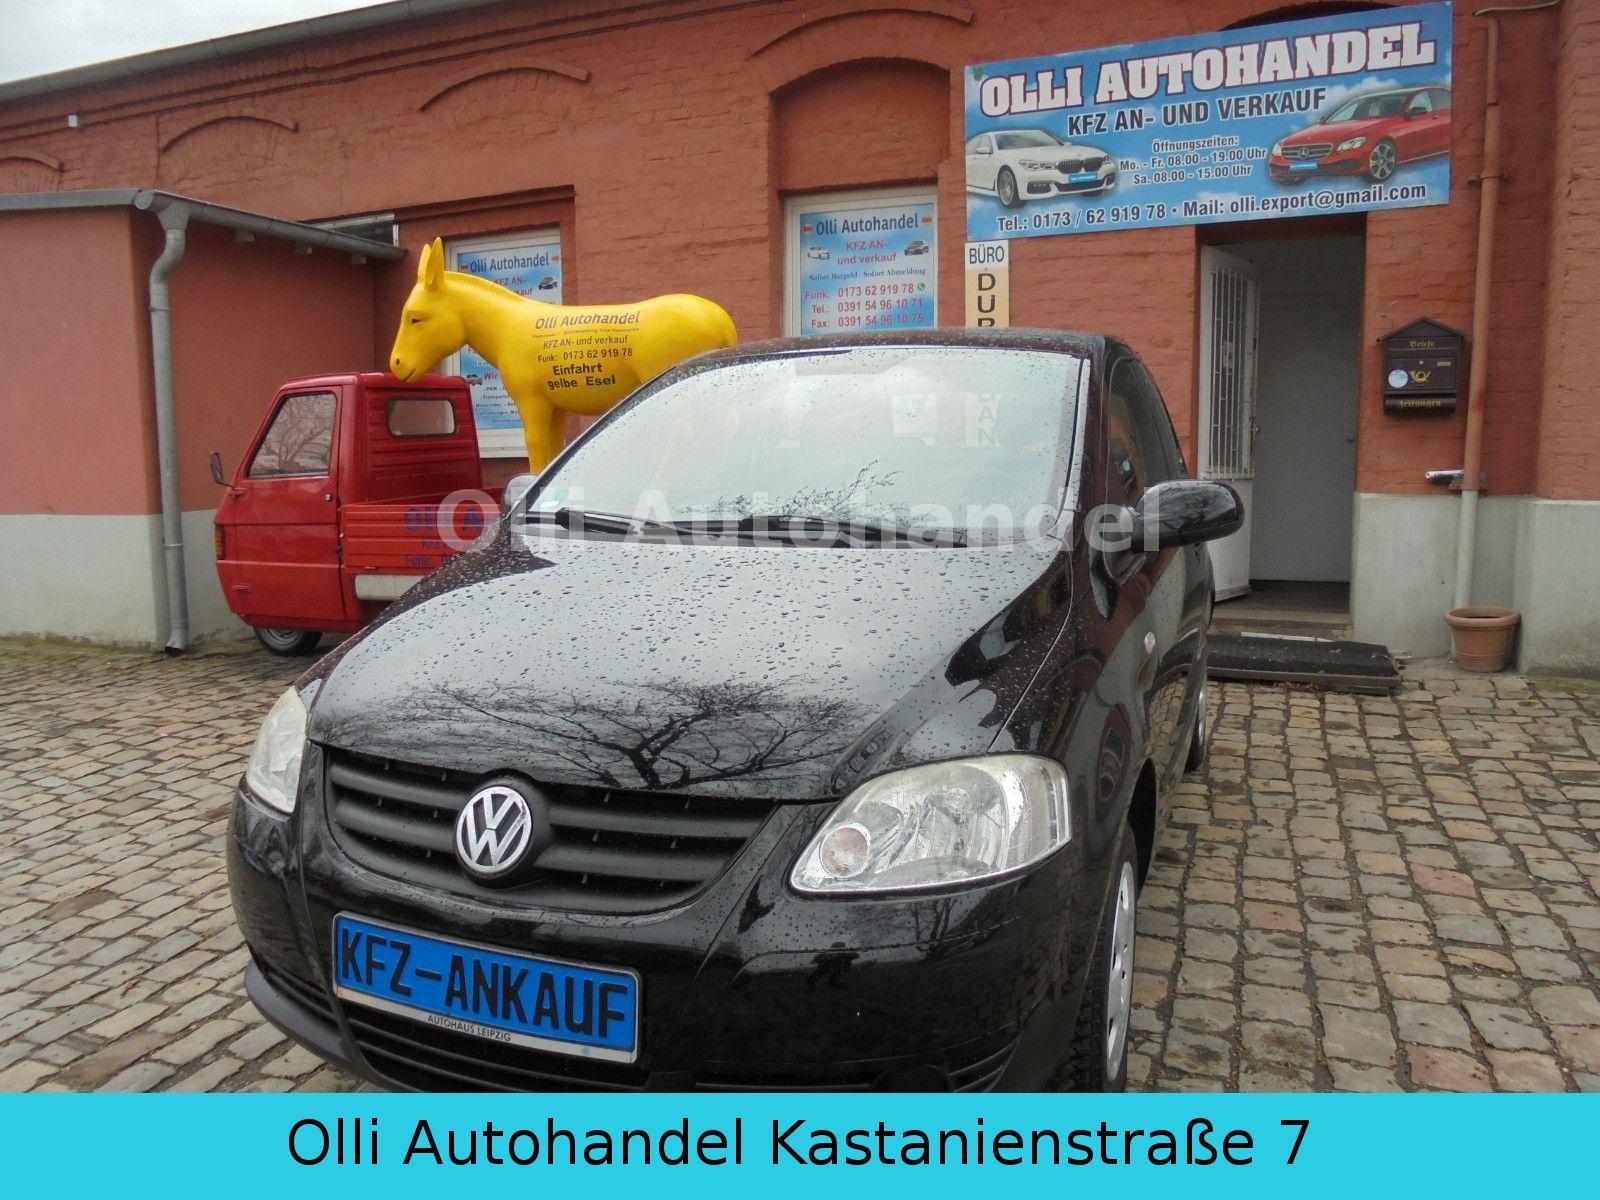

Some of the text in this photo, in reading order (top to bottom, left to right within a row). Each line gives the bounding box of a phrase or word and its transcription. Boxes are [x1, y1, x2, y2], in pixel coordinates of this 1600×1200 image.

[980, 20, 1438, 117] OLLI AUTOHANDEL
[1068, 87, 1326, 136] KFZ AN- UND VERKAUF
[1153, 136, 1238, 152] Öffnungszeiten:
[1120, 160, 1139, 171] Mo.
[1151, 157, 1164, 168] Fr.
[1168, 154, 1199, 166] 08.00
[1212, 150, 1243, 162] 19.00
[1247, 148, 1267, 159] Uhr
[1134, 174, 1150, 185] Sa.
[1154, 170, 1185, 183] 08.00
[1198, 166, 1229, 179] 15.00
[1232, 164, 1252, 176] Uhr
[998, 217, 1028, 232] Tel.:
[1033, 211, 1071, 230] 0173
[1086, 208, 1105, 224] 62
[1111, 205, 1140, 222] 919
[1146, 203, 1166, 219] 78
[1183, 198, 1224, 217] Mail:
[1230, 184, 1427, 215] olli.export@gmail.com
[816, 212, 919, 236] Olli Autohandel
[846, 240, 867, 252] KFZ
[969, 244, 1005, 265] BÜRO
[470, 251, 550, 273] Olli Autohandel
[837, 252, 897, 265] und verkauf
[863, 268, 885, 278] Sofort
[837, 285, 862, 298] 0173
[864, 284, 877, 296] 62
[879, 283, 899, 295] 919
[902, 282, 914, 294] 78
[837, 301, 861, 312] 0391
[864, 299, 877, 311] 54
[535, 311, 641, 329] Olli Autohandel
[811, 318, 830, 329] Fax:
[837, 315, 862, 328] 0391
[865, 314, 877, 326] 54
[543, 340, 559, 349] KFZ
[576, 335, 593, 345] und
[594, 335, 629, 345] verkauf
[537, 347, 633, 363] Funk: 0173 62 919 78
[553, 363, 604, 376] Einfahrt
[548, 374, 616, 390] gelbe Esel
[341, 928, 629, 1038] KFZ-ANKAUF
[427, 1014, 512, 1042] AUTOHAUS LEIPZIG
